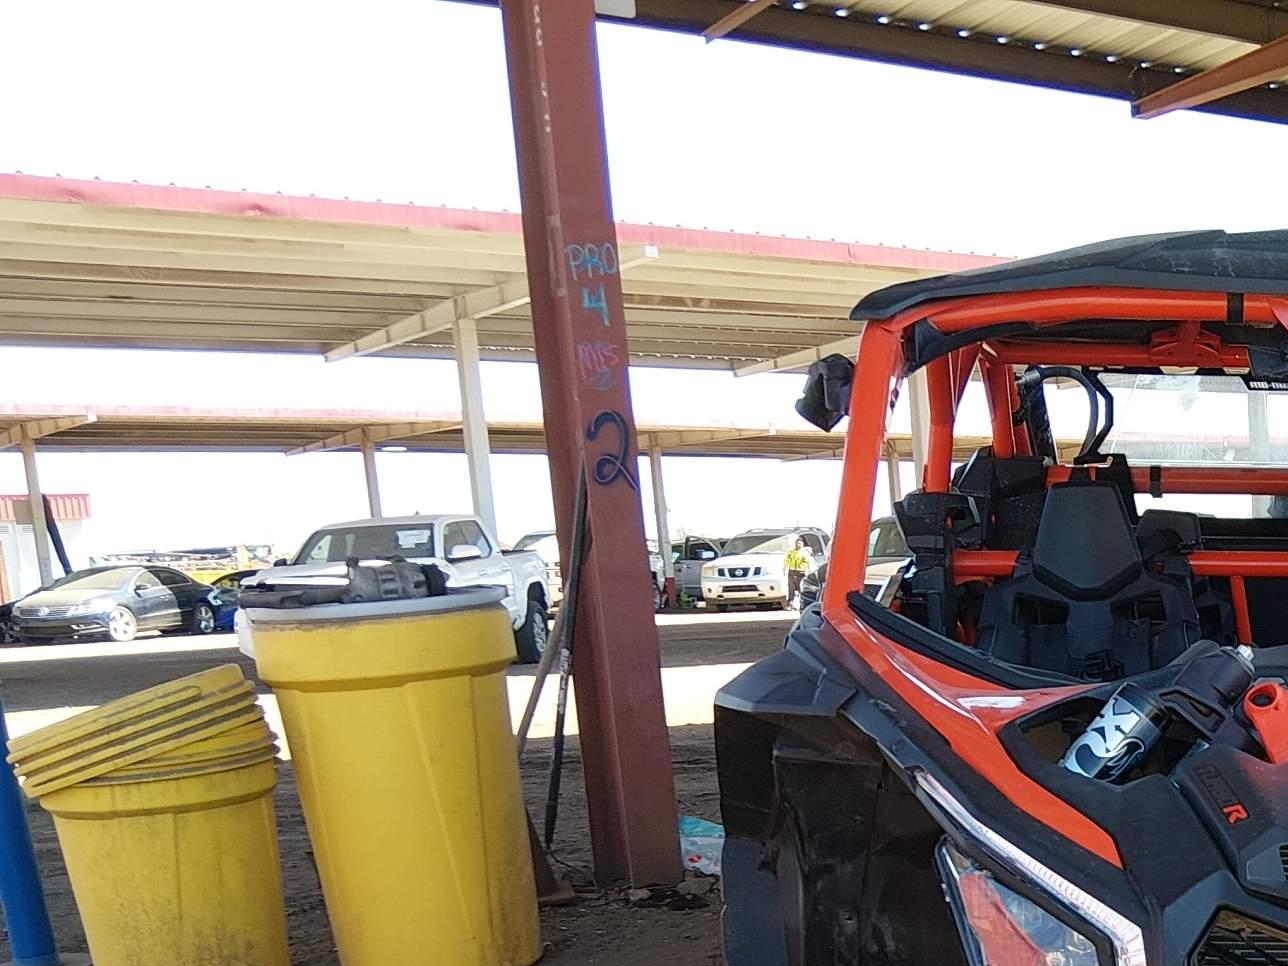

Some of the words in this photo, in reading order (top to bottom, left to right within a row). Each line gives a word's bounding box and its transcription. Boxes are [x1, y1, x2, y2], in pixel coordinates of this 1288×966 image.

[564, 242, 618, 281] PRO
[581, 283, 611, 327] 4
[586, 409, 639, 492] 2
[1221, 804, 1248, 824] R
